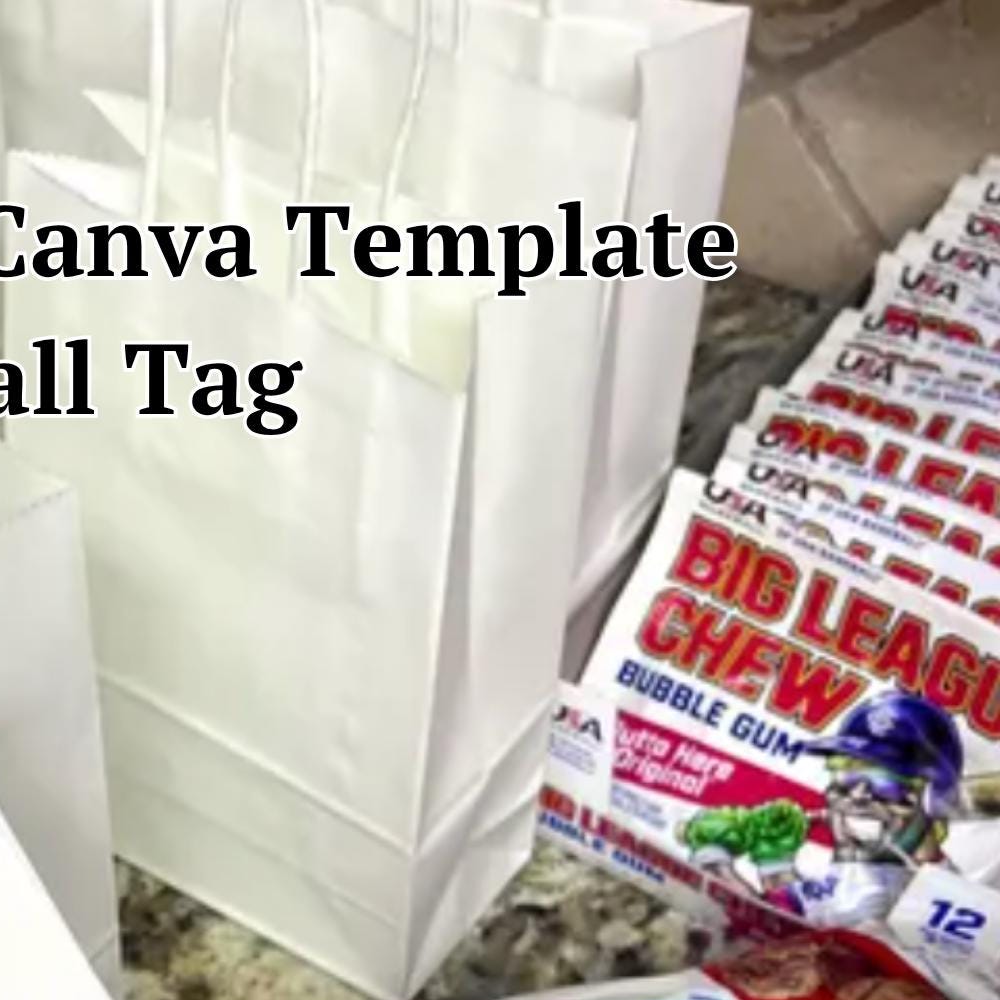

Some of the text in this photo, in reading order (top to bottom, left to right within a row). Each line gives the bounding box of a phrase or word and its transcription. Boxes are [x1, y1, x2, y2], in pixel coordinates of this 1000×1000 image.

[665, 512, 801, 626] BIG
[616, 658, 804, 765] BUBBLE GUM
[637, 586, 871, 733] CHEW
[616, 720, 671, 758] utta
[928, 898, 988, 941] 12
